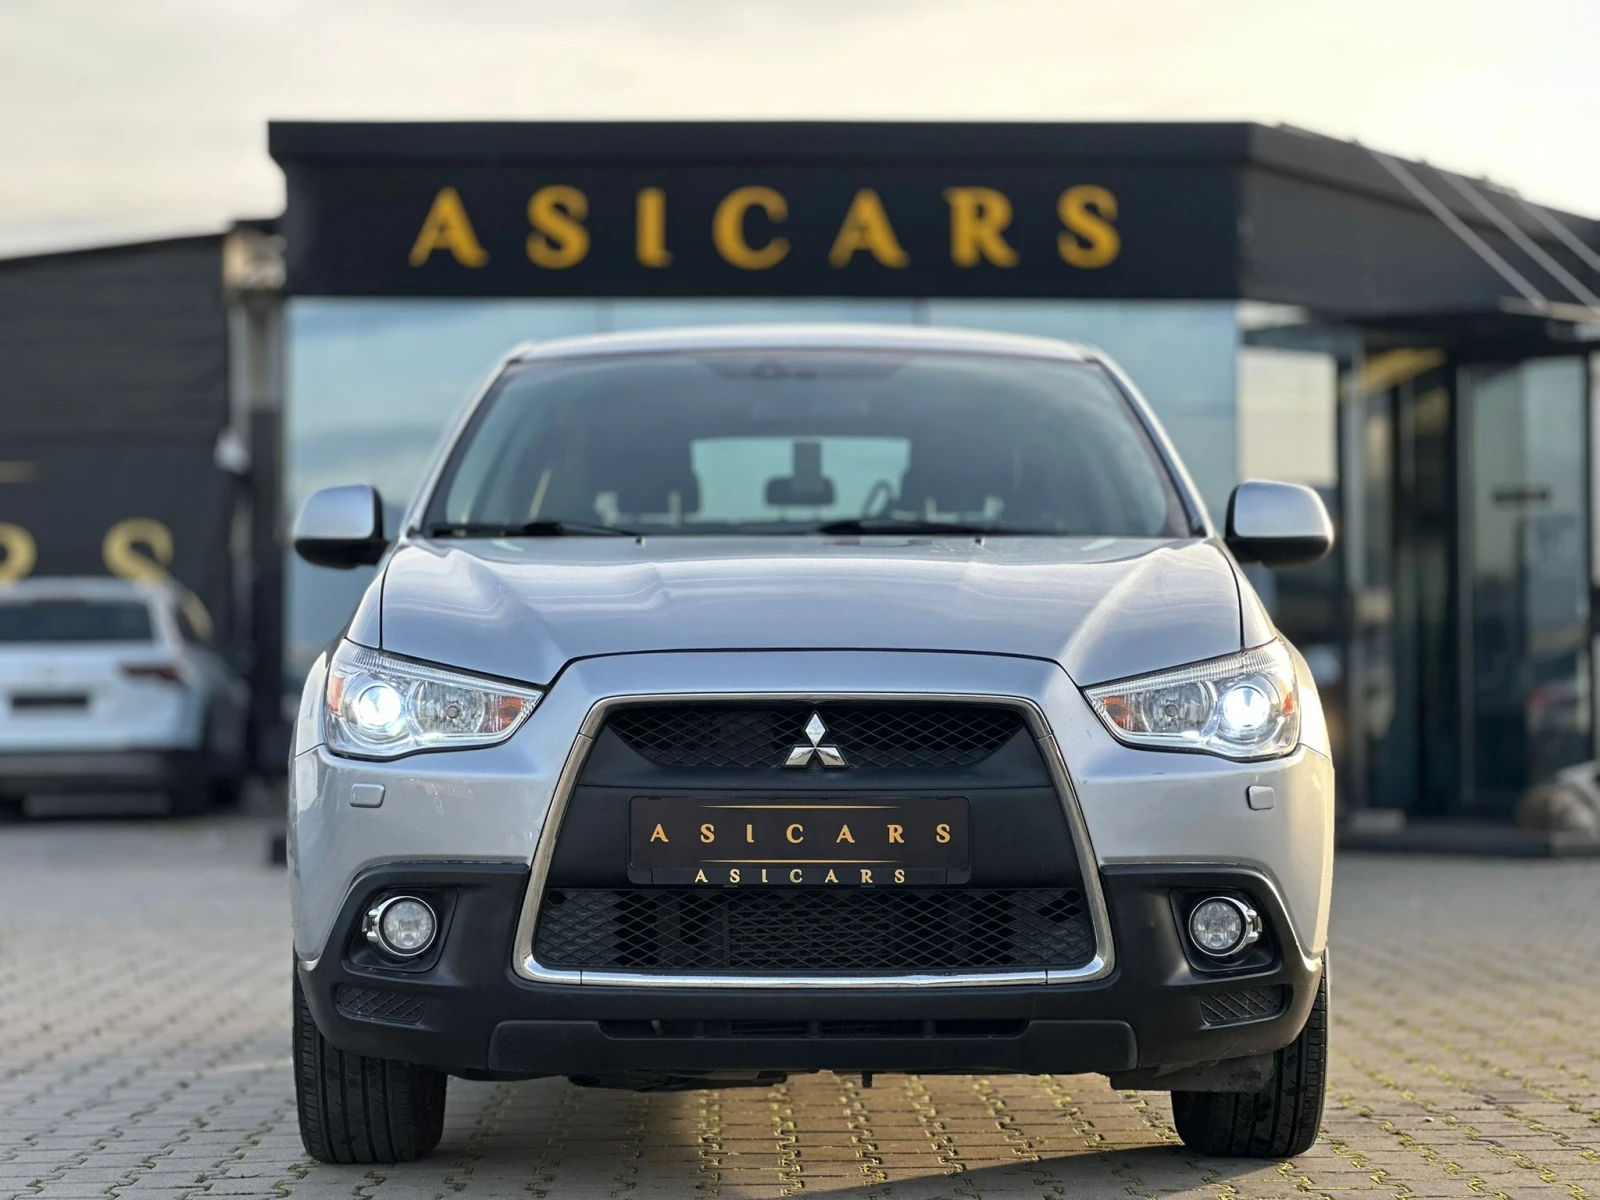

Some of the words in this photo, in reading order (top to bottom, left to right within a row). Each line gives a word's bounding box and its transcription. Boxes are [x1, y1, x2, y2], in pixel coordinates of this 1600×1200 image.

[409, 185, 1121, 269] ASICARS
[650, 823, 952, 844] ASICARS
[694, 868, 906, 884] ASICARS
